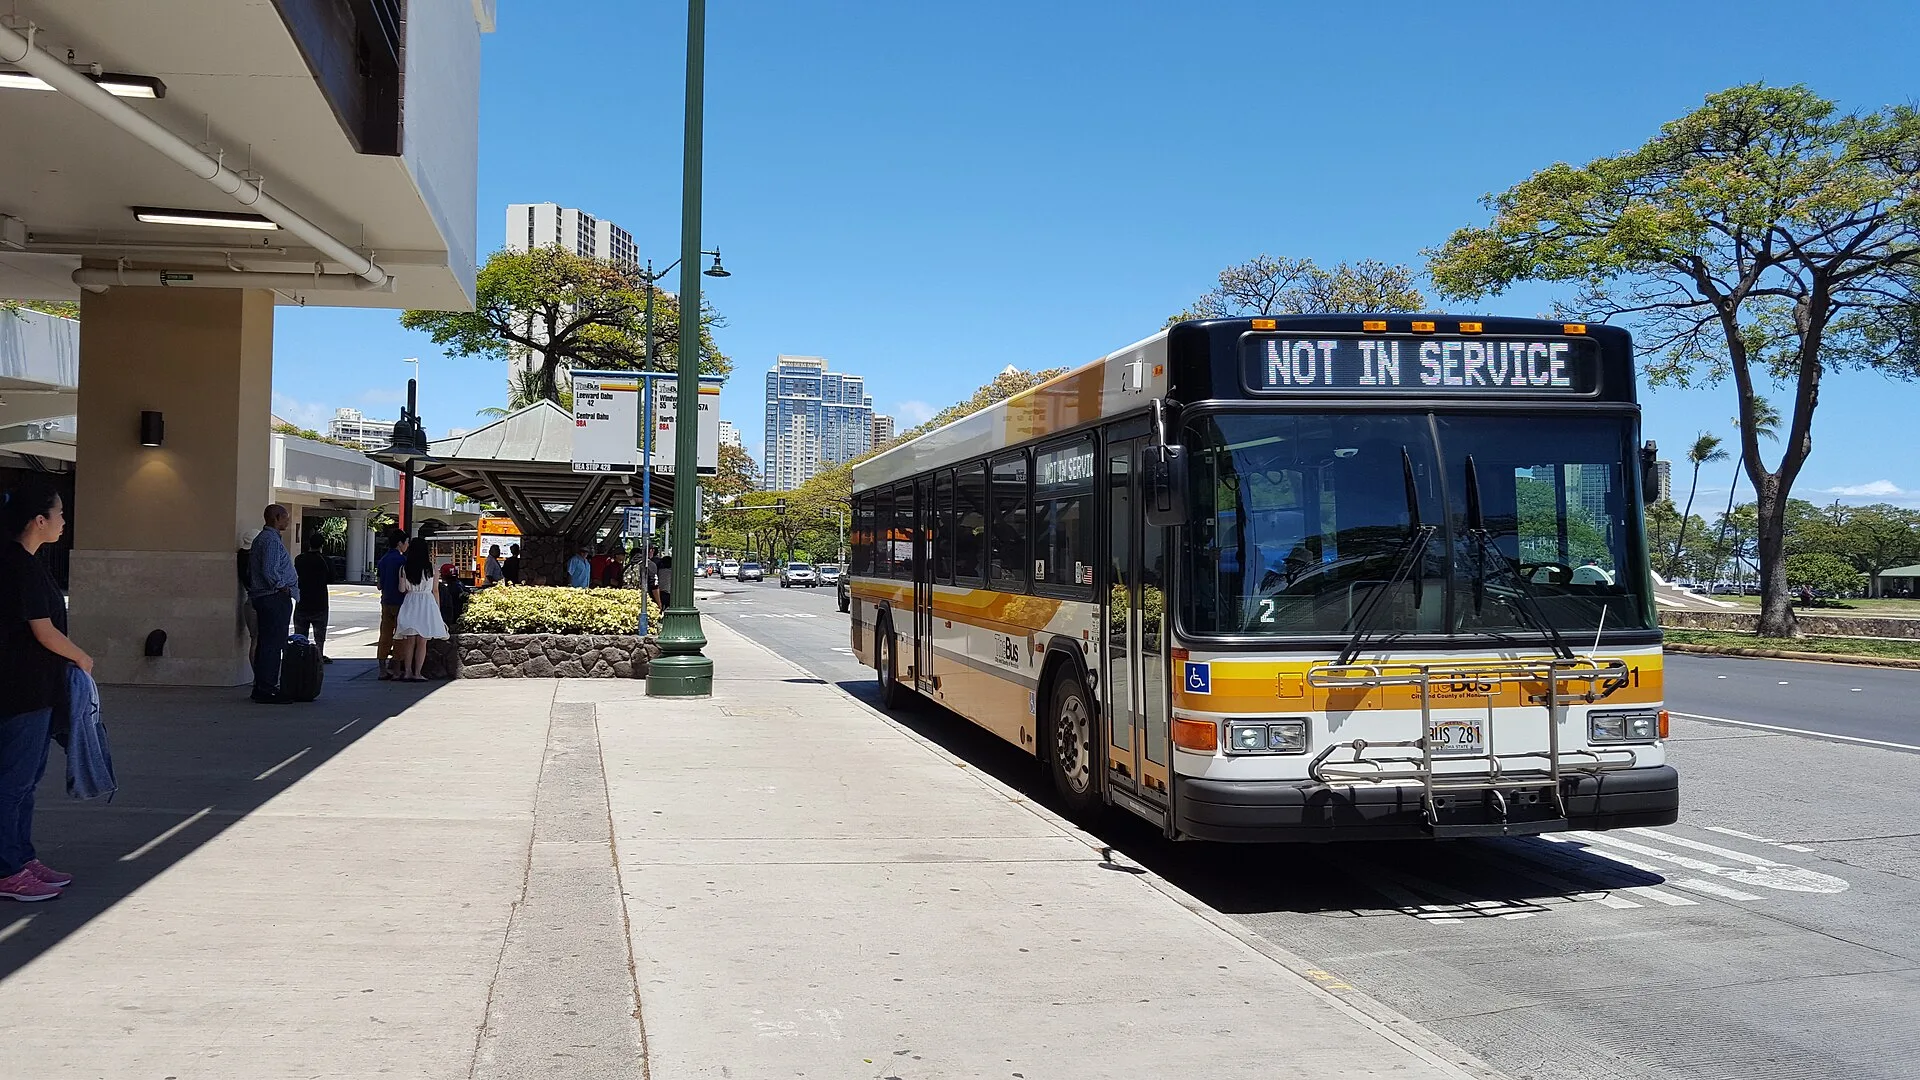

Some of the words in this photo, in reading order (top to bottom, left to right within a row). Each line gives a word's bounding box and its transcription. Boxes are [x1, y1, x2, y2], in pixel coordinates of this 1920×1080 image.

[1267, 340, 1338, 385] NOT
[1358, 341, 1400, 385] IN
[1419, 341, 1571, 386] SERVICE
[576, 391, 600, 399] Leeward
[587, 399, 595, 407] 42
[576, 411, 596, 420] Central
[659, 415, 675, 423] North
[585, 463, 600, 471] STOP
[1045, 462, 1056, 484] NOT
[1058, 459, 1067, 482] IN
[1260, 599, 1275, 623] 2
[1458, 726, 1480, 744] 281
